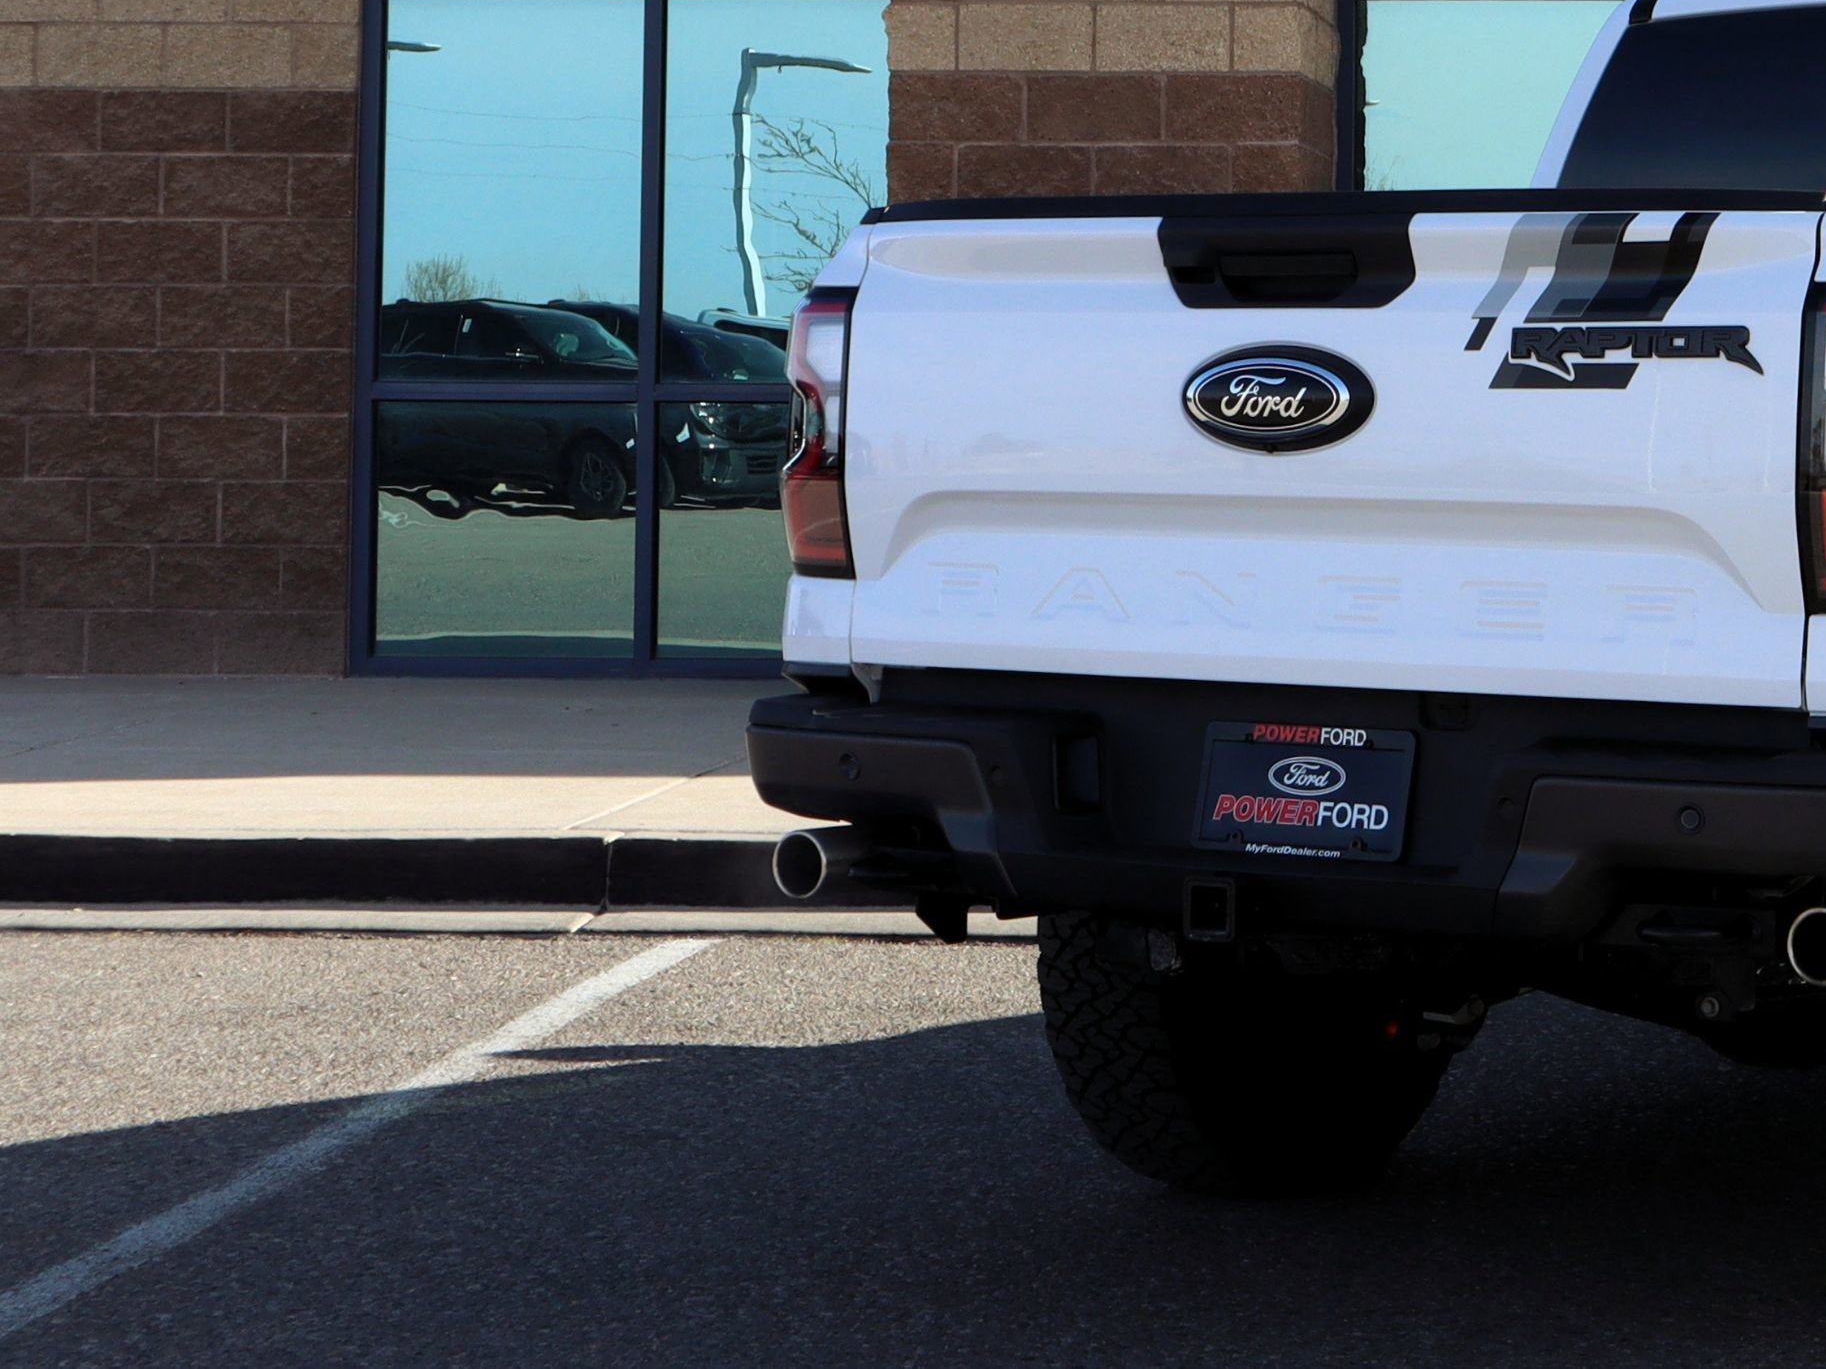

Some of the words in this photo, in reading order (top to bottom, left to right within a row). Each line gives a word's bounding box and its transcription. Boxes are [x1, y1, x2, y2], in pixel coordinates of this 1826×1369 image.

[1510, 325, 1764, 377] RAPTOR
[1219, 374, 1307, 419] Ford
[921, 559, 1699, 647] RANGER
[1253, 722, 1367, 747] POWERFORD
[1283, 761, 1331, 788] Ford
[1212, 794, 1389, 831] POWERFORD
[1245, 842, 1341, 859] MyFordDealer.com
